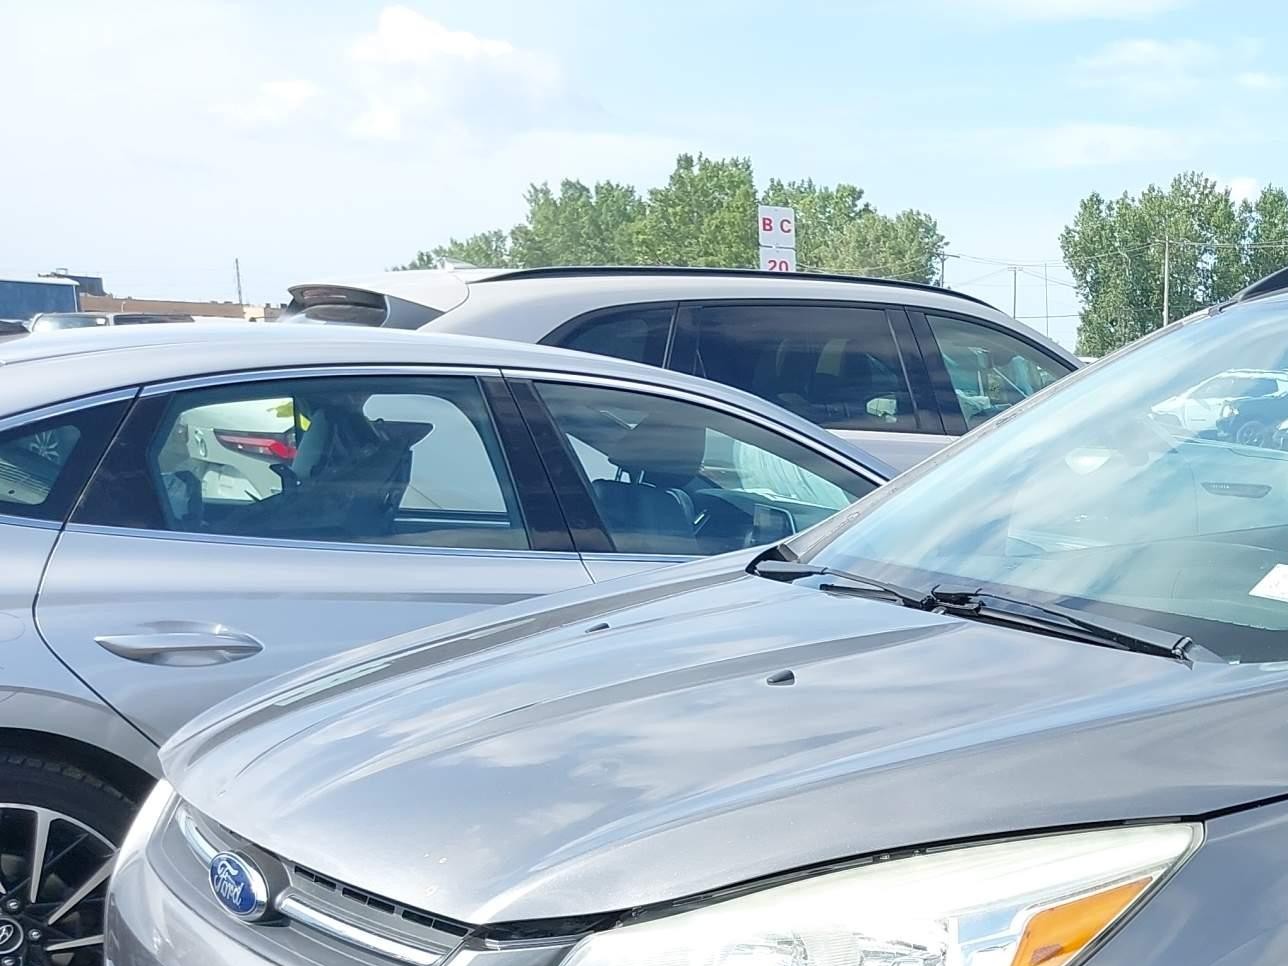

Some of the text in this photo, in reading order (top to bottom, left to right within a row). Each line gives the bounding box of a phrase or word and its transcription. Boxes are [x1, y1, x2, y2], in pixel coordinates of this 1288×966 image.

[762, 217, 792, 233] B C
[767, 259, 789, 272] 20
[213, 860, 245, 906] Ford
